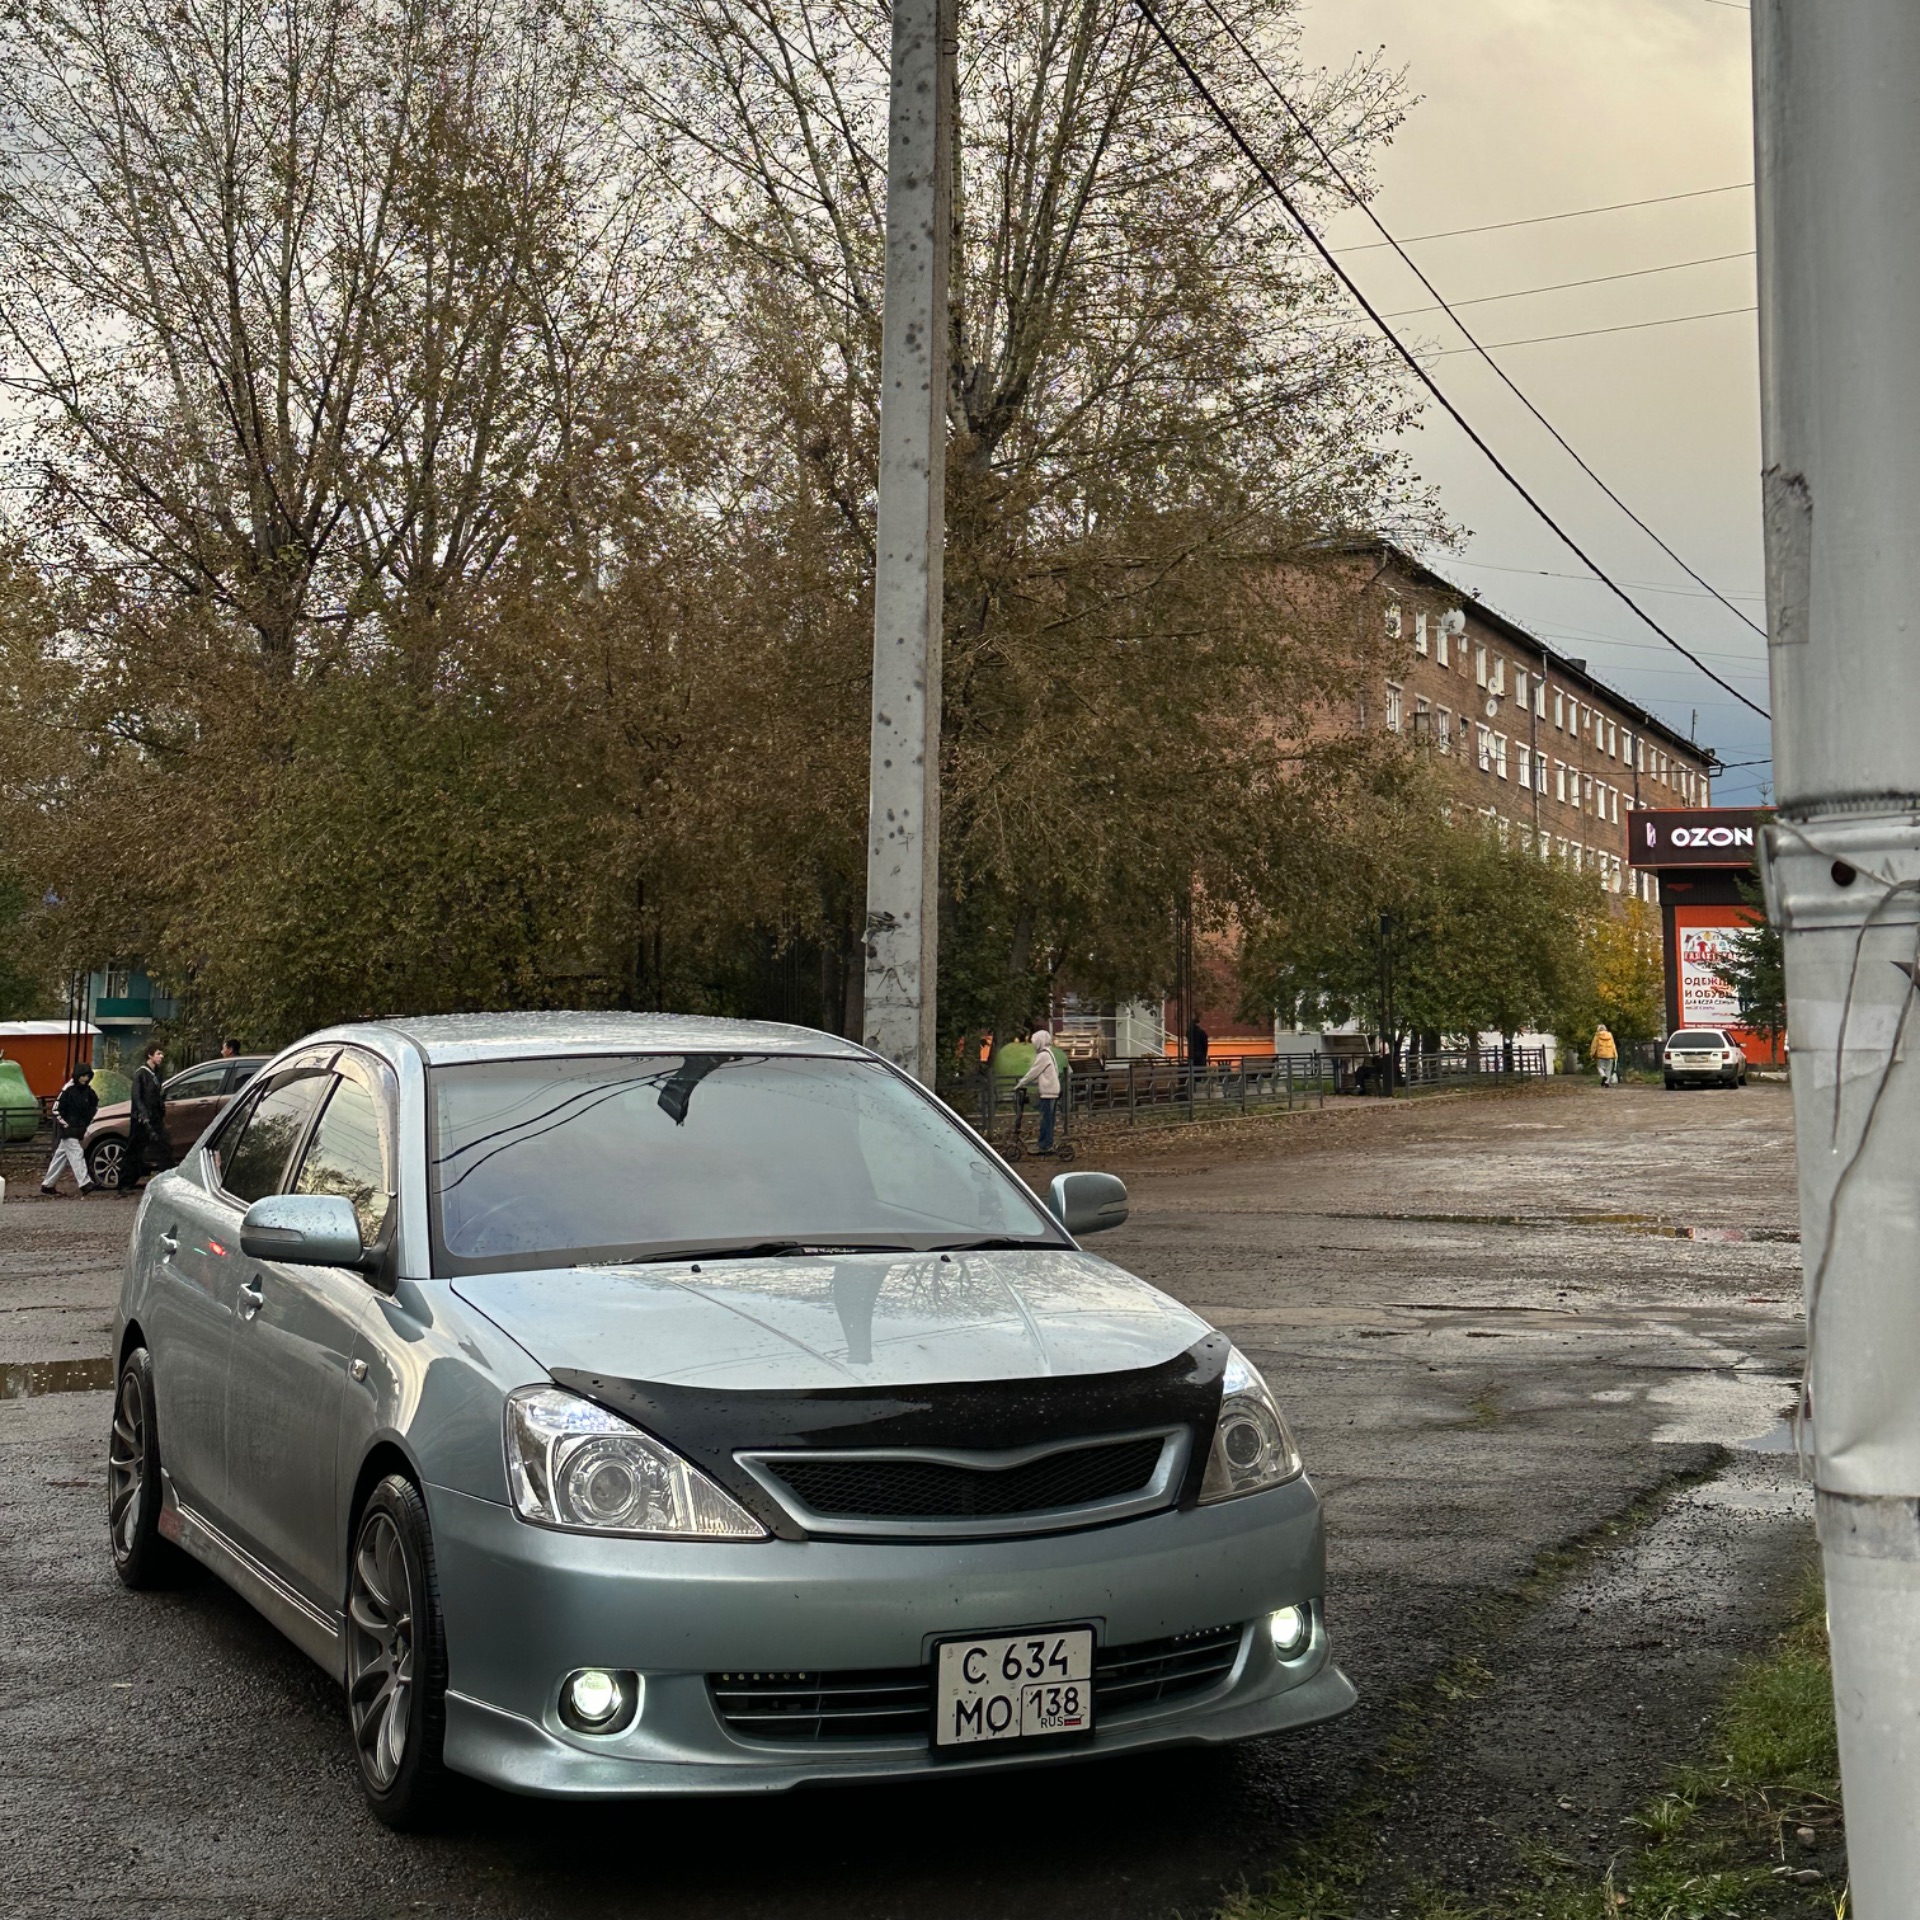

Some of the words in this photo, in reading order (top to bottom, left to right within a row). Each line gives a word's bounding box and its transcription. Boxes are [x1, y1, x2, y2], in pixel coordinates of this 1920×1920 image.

[1671, 827, 1754, 847] OZON
[1685, 990, 1692, 998] И
[1002, 1639, 1068, 1680] 634
[1029, 1686, 1079, 1719] 138
[1040, 1716, 1064, 1728] RUS
